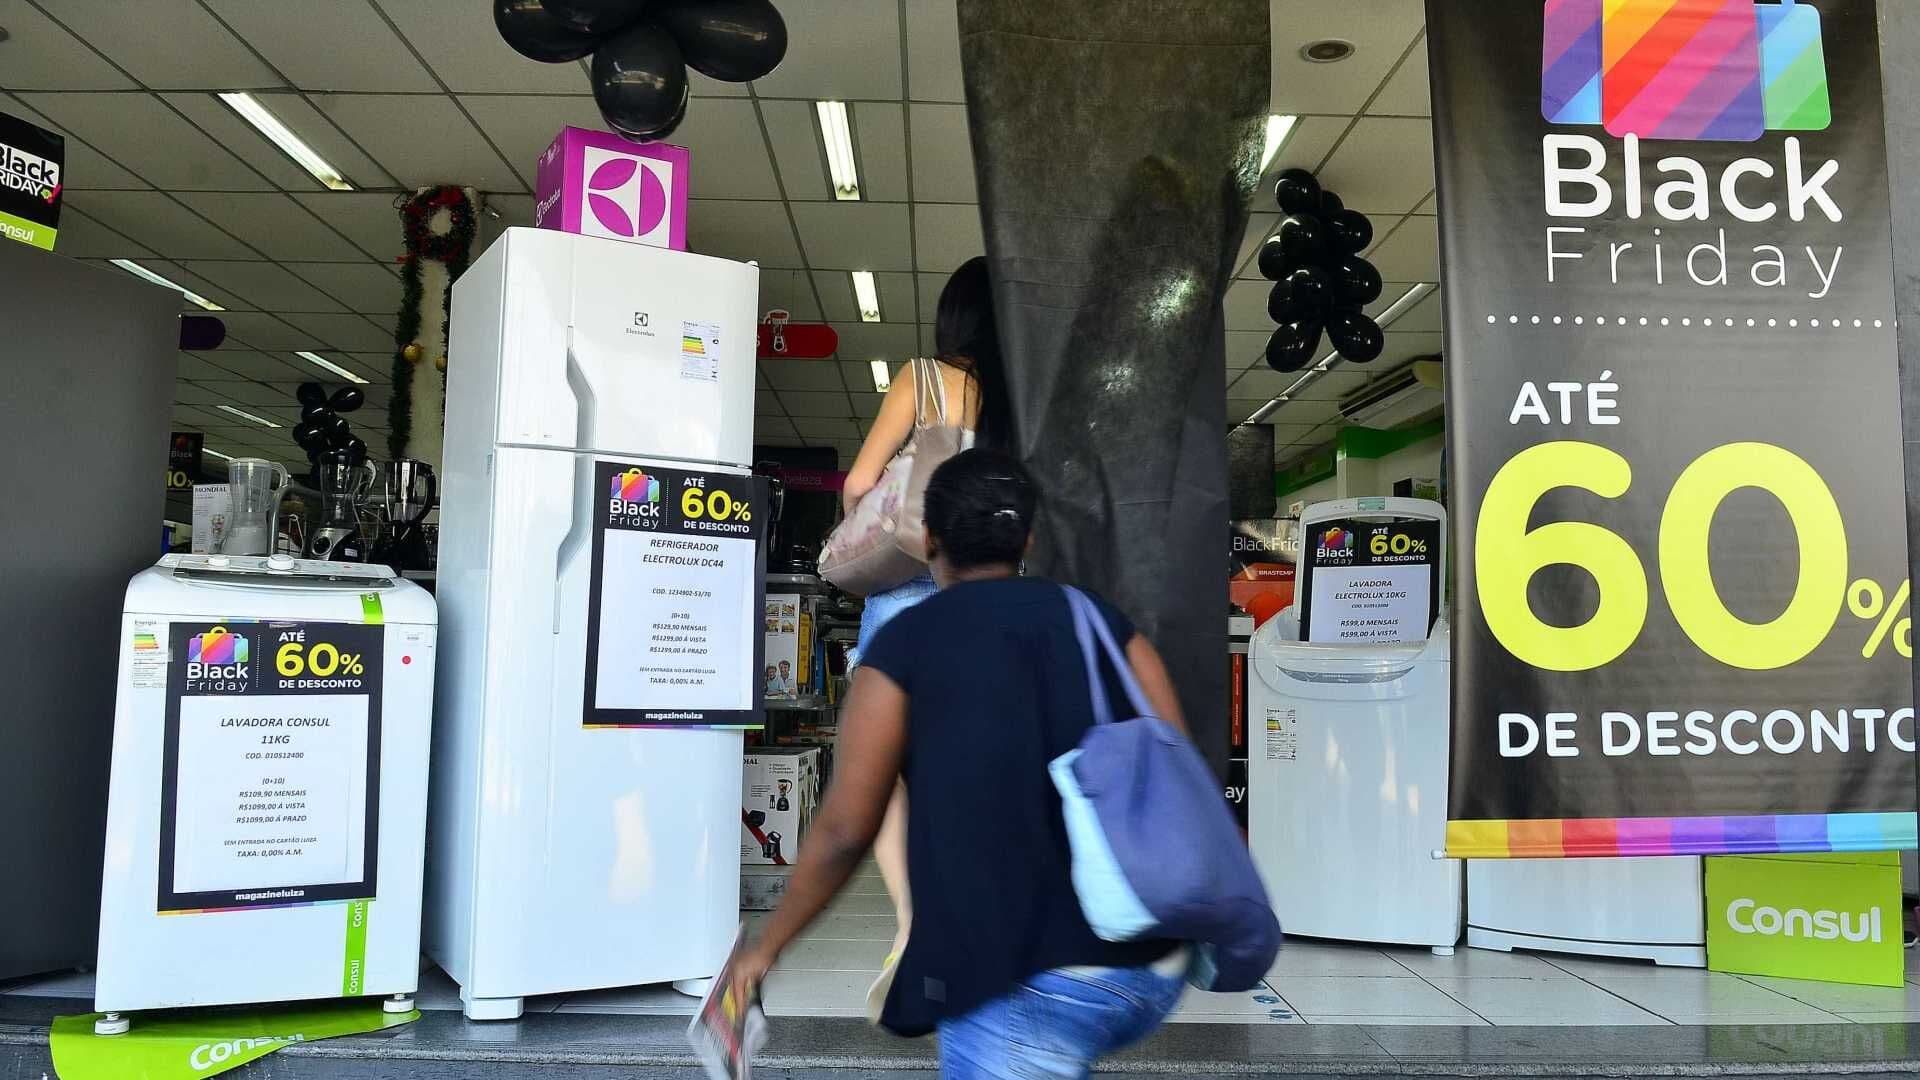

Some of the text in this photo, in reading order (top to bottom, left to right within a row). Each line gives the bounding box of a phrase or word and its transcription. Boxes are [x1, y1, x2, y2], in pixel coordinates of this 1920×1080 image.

[1542, 132, 1843, 223] Black
[1546, 226, 1843, 299] Friday
[1508, 369, 1621, 425] ATÉ
[683, 477, 705, 488] ATÉ
[609, 499, 660, 517] Black
[681, 487, 752, 521] 60%
[609, 514, 659, 529] Friday
[683, 521, 750, 534] DE DESCONTO
[1371, 526, 1389, 535] ATÉ
[650, 539, 719, 552] REFRIGERADOR
[1370, 533, 1427, 555] 60%
[1316, 548, 1354, 558] Black
[1474, 440, 1913, 672] 60%
[642, 554, 724, 569] ELECTROLUX DC44
[1316, 557, 1353, 565] Friday
[1349, 580, 1392, 588] LAVADORA
[1335, 591, 1407, 600] ELECTROLUX 10KG
[680, 624, 707, 632] MENSAIS
[1366, 618, 1398, 626] MENSAIS
[279, 630, 305, 642] ATÉ
[276, 642, 364, 677] 60%
[187, 662, 248, 680] Black
[186, 679, 248, 692] Friday
[279, 679, 362, 688] DE DESCONTO
[645, 711, 703, 721] magazineluiza
[220, 718, 331, 727] LAVADORA CONSUL
[261, 735, 290, 744] 11KG
[1498, 712, 1580, 758] DE
[262, 777, 285, 785] (0+10)
[238, 803, 277, 811] R$1099,00
[236, 816, 274, 824] R$1099,00
[282, 815, 307, 823] PRAZO
[237, 850, 259, 858] TAXA:
[261, 849, 284, 858] 0,00%
[235, 889, 305, 901] magazineluiza
[1726, 898, 1882, 943] Consul
[349, 959, 360, 994] Consul
